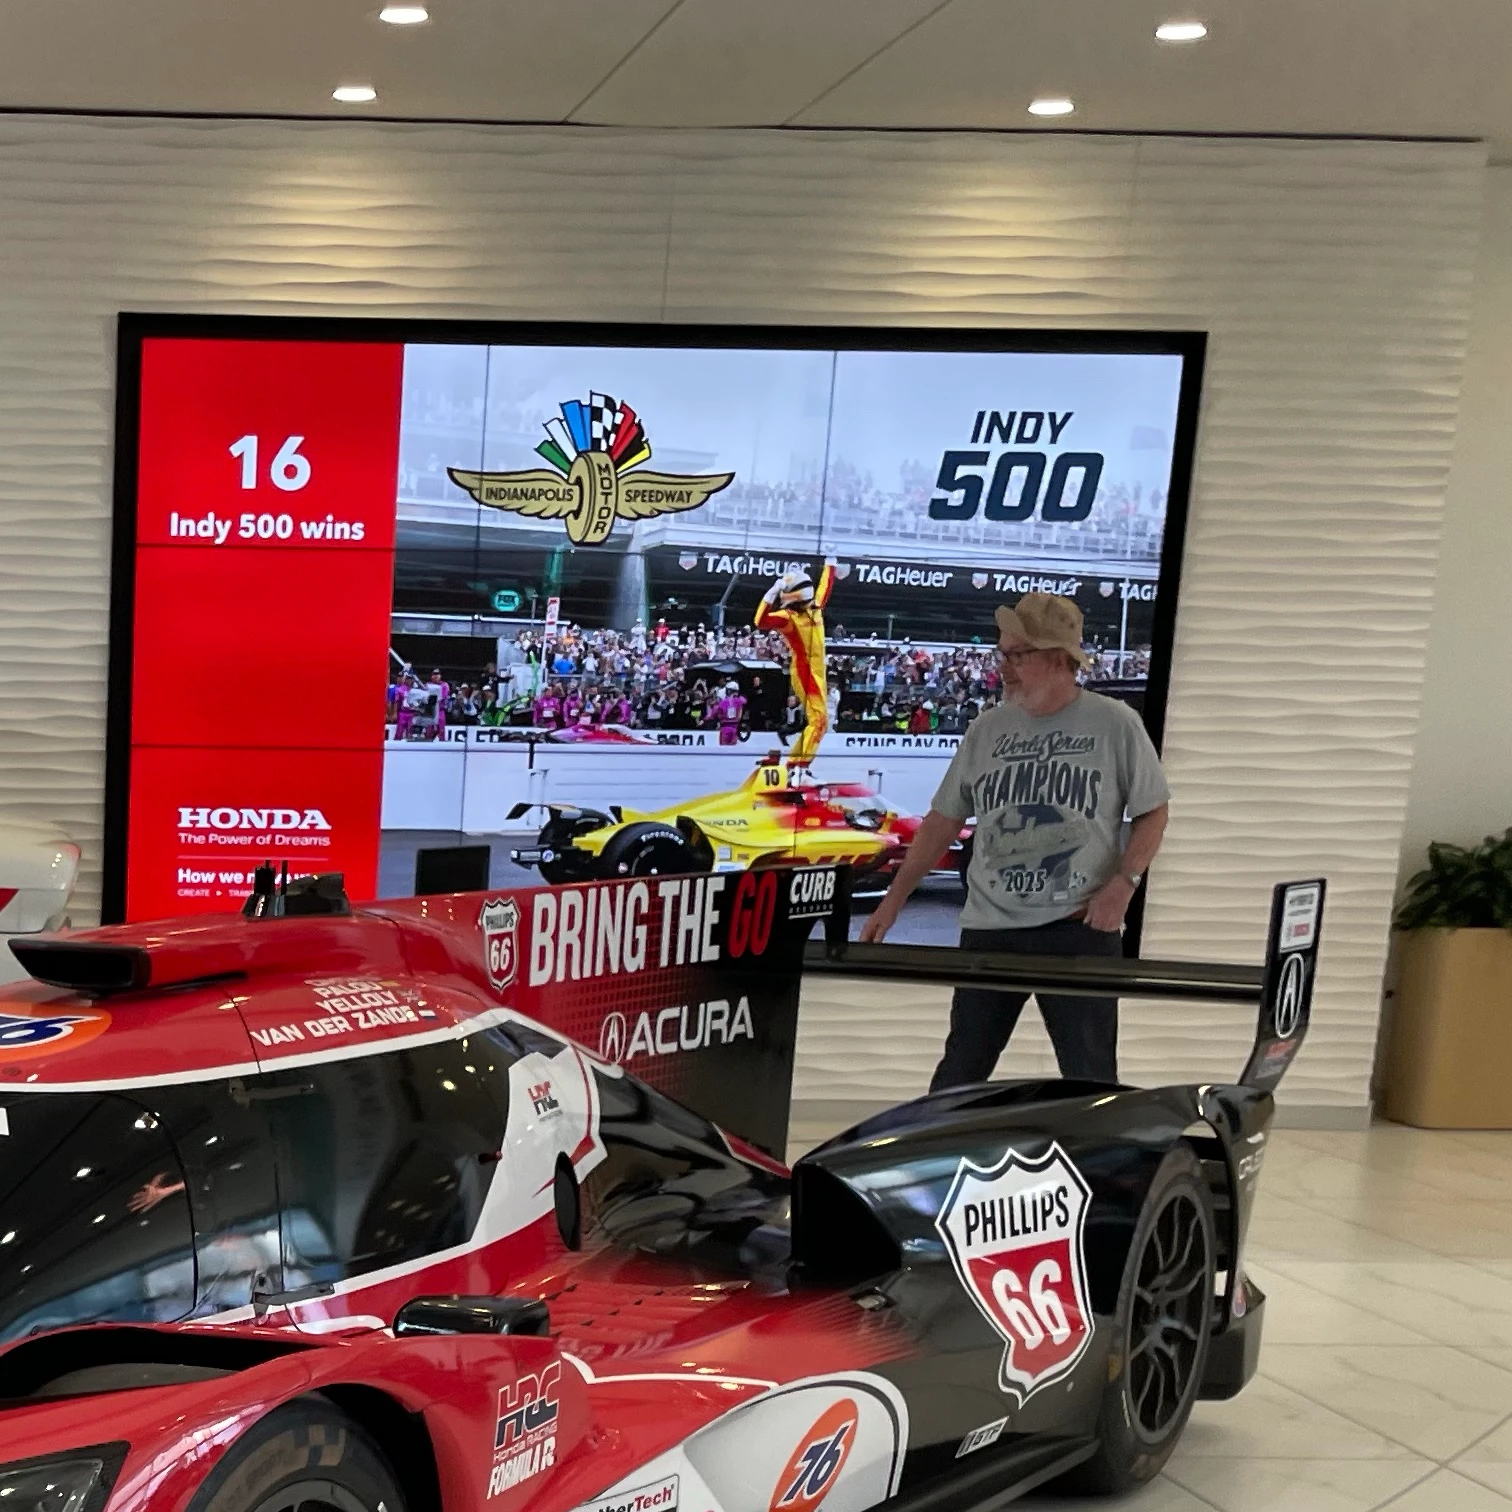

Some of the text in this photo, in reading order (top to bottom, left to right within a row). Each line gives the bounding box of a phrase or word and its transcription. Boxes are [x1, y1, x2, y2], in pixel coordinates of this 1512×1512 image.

[970, 411, 1074, 444] INDY
[229, 434, 311, 491] 16
[485, 487, 574, 502] INDIANAPOLIS
[593, 463, 613, 534] MOTOR
[625, 489, 693, 503] SPEEDWAY
[928, 450, 1104, 522] 500
[170, 512, 365, 544] Indy 500 wins
[1039, 730, 1096, 762] Series
[764, 769, 780, 786] 10
[973, 761, 1101, 820] CHAMPIONS
[177, 807, 332, 830] HONDA
[178, 833, 330, 846] The Power of Dreams
[178, 868, 216, 883] How
[219, 872, 243, 883] we
[790, 871, 837, 904] CURB
[1005, 869, 1047, 893] 2025
[529, 870, 777, 986] BRING THE GO
[490, 938, 512, 972] 66
[316, 991, 400, 1014] YELLOLY
[250, 1005, 419, 1046] VAN DER ZANDE
[626, 996, 755, 1060] ACURA
[964, 1185, 1070, 1246] PHILLIPS
[992, 1258, 1071, 1350] 66
[494, 1360, 561, 1450] HRC
[775, 1418, 856, 1508] 76
